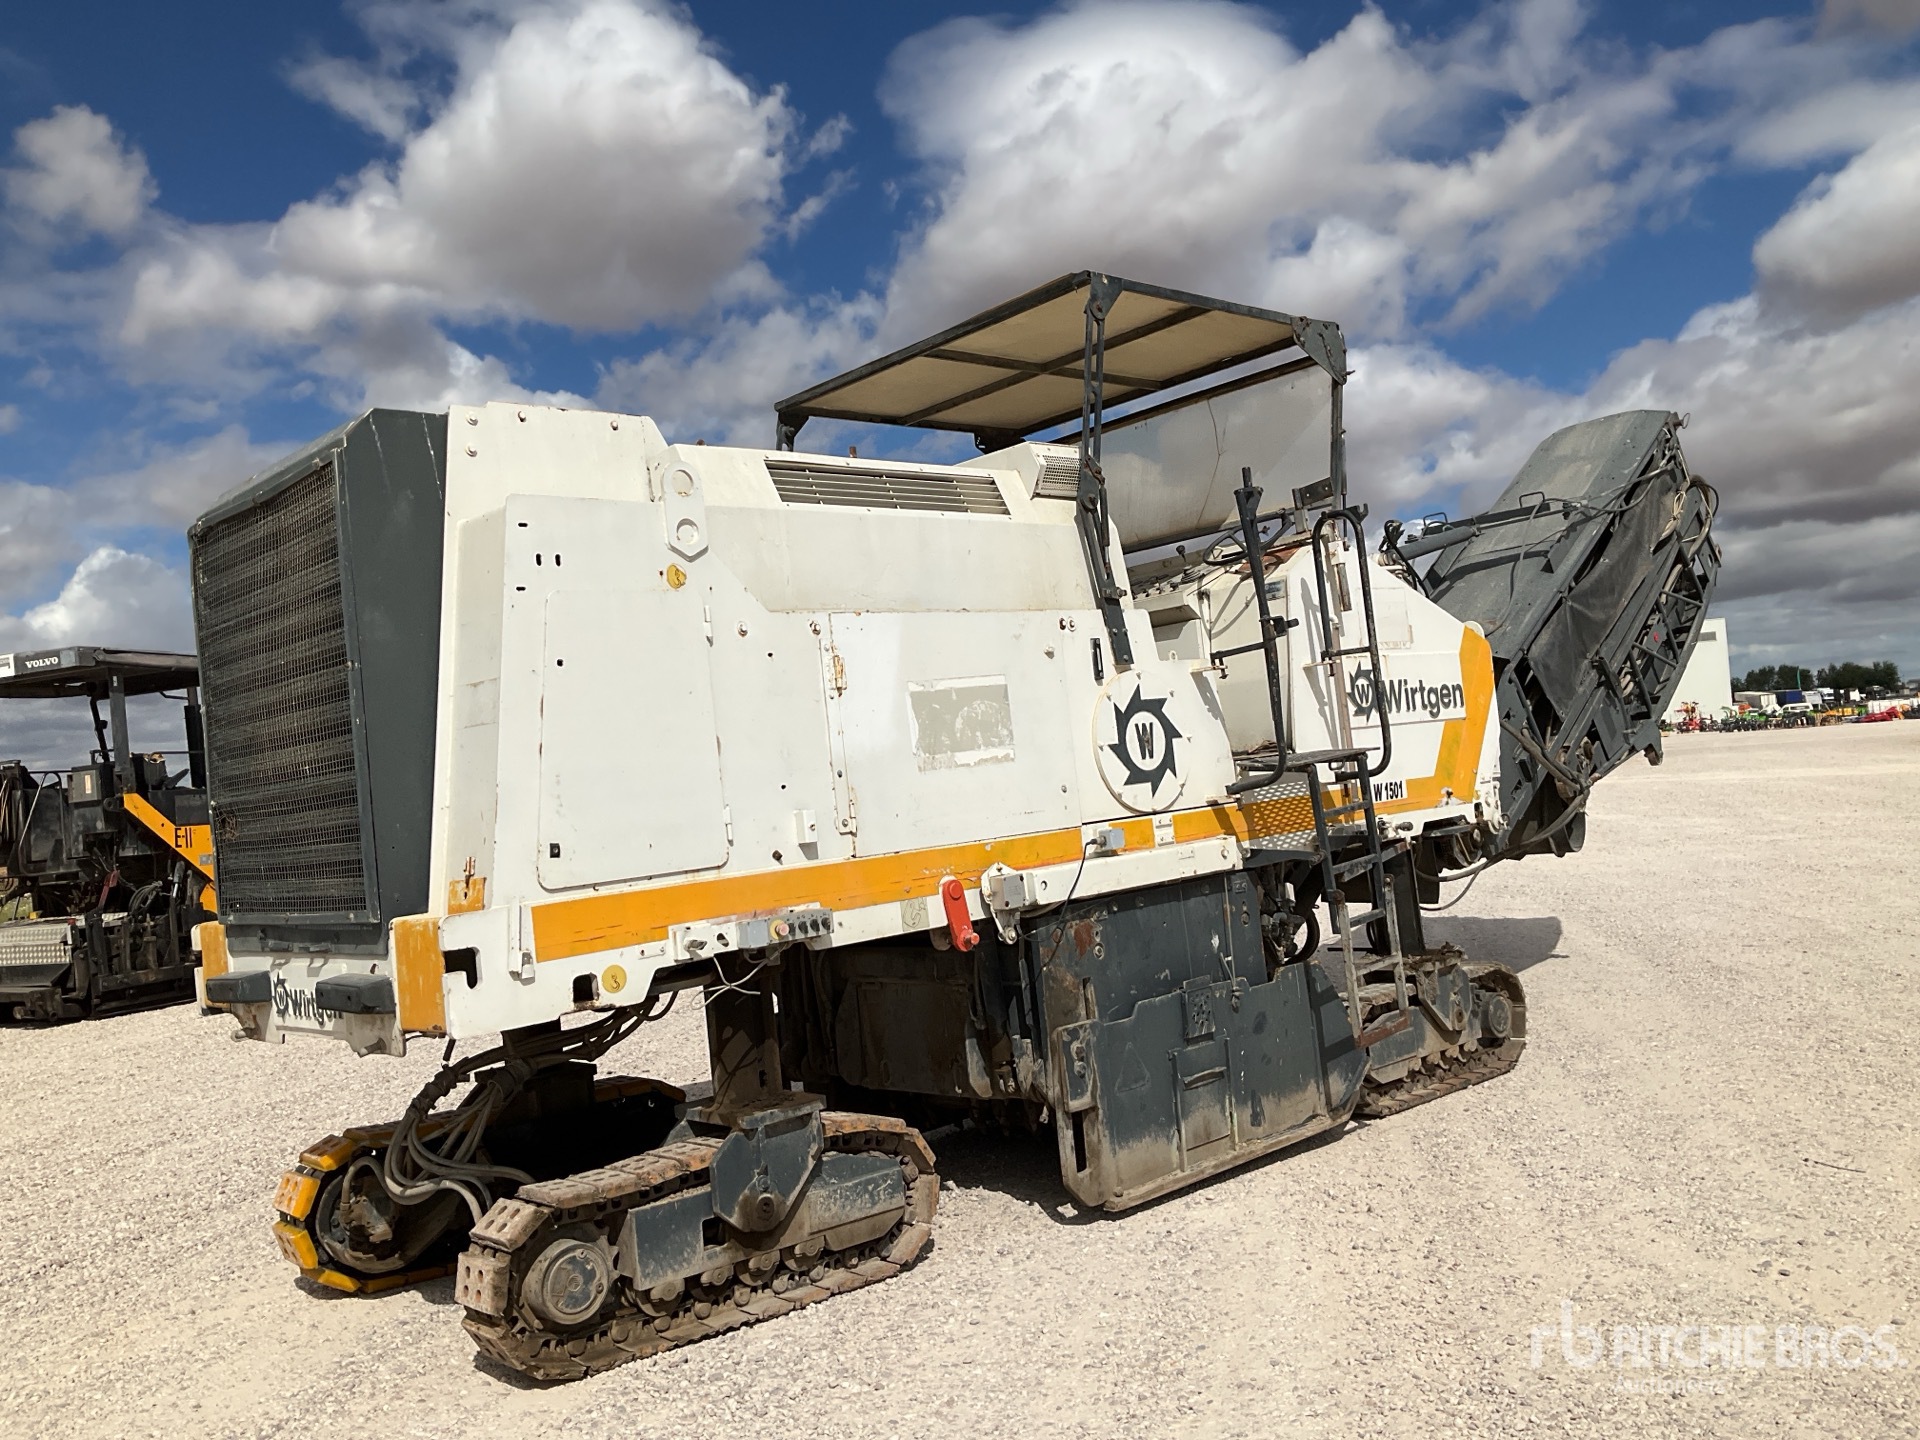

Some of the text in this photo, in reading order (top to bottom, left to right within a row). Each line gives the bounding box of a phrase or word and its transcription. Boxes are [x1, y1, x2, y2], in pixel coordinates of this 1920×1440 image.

[25, 656, 59, 669] VOLVO
[1379, 678, 1465, 719] Wirtgen
[1134, 721, 1154, 760] W
[1373, 780, 1403, 802] W 1501
